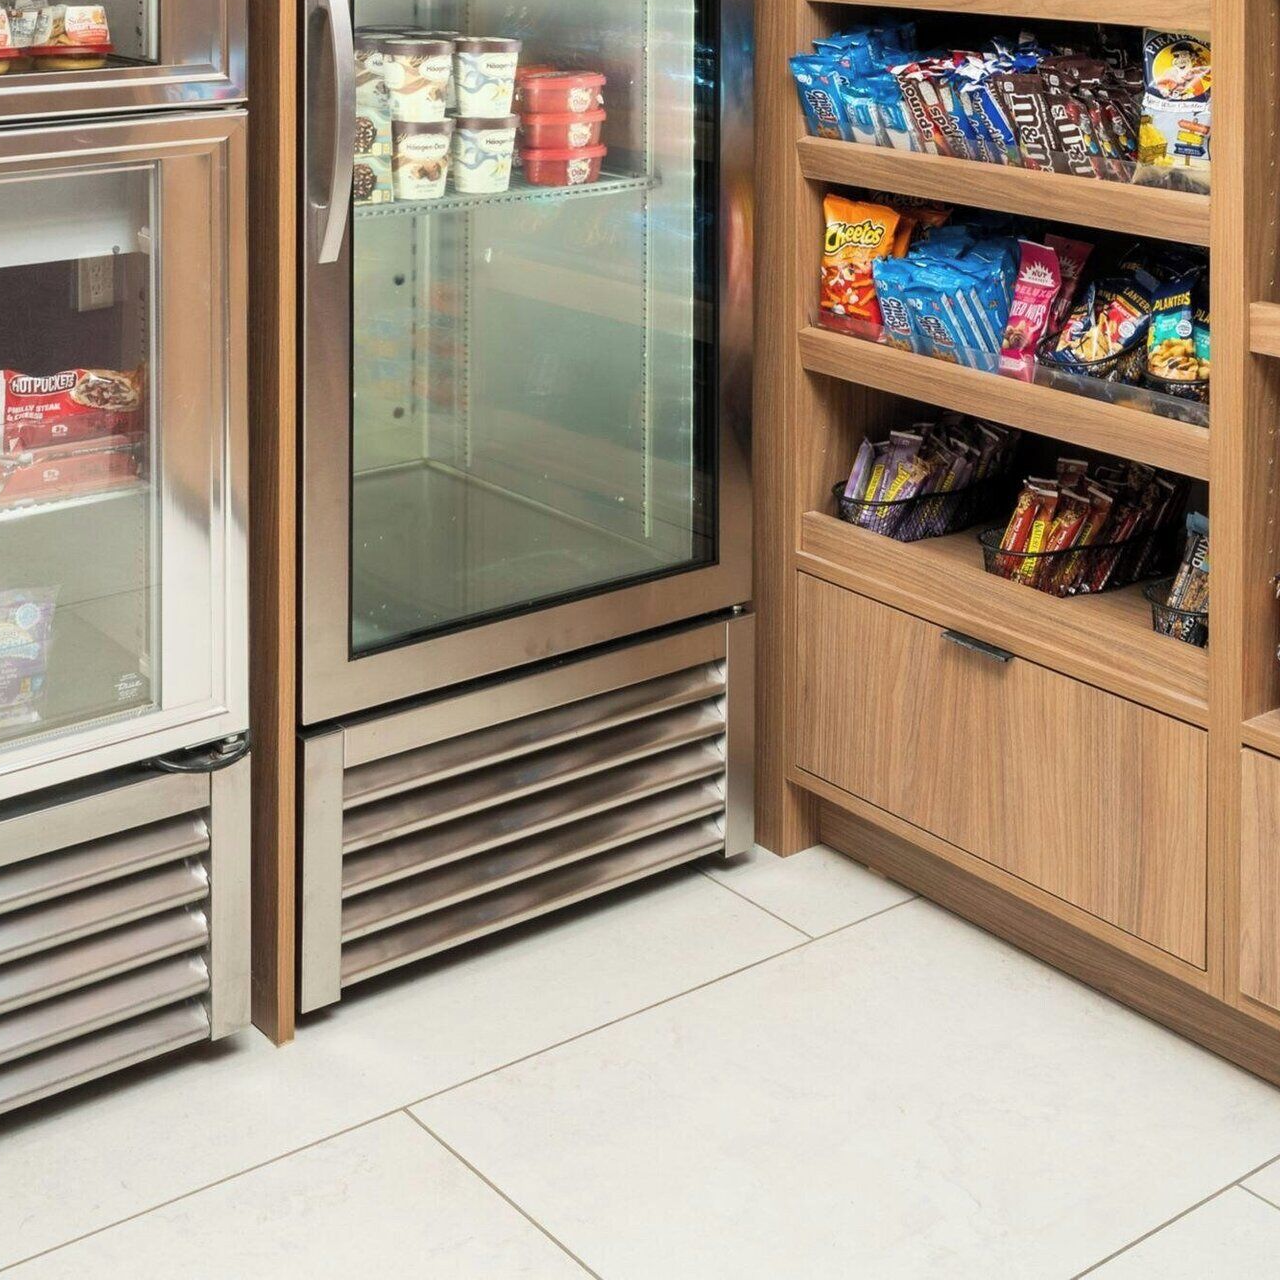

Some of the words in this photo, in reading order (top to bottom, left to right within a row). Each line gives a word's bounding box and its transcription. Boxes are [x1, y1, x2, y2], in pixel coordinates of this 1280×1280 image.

[824, 220, 884, 253] Cheetos
[1032, 270, 1047, 279] NUT
[1153, 291, 1191, 312] PLANTERS
[12, 379, 33, 394] HOT
[34, 372, 76, 392] POCKETS
